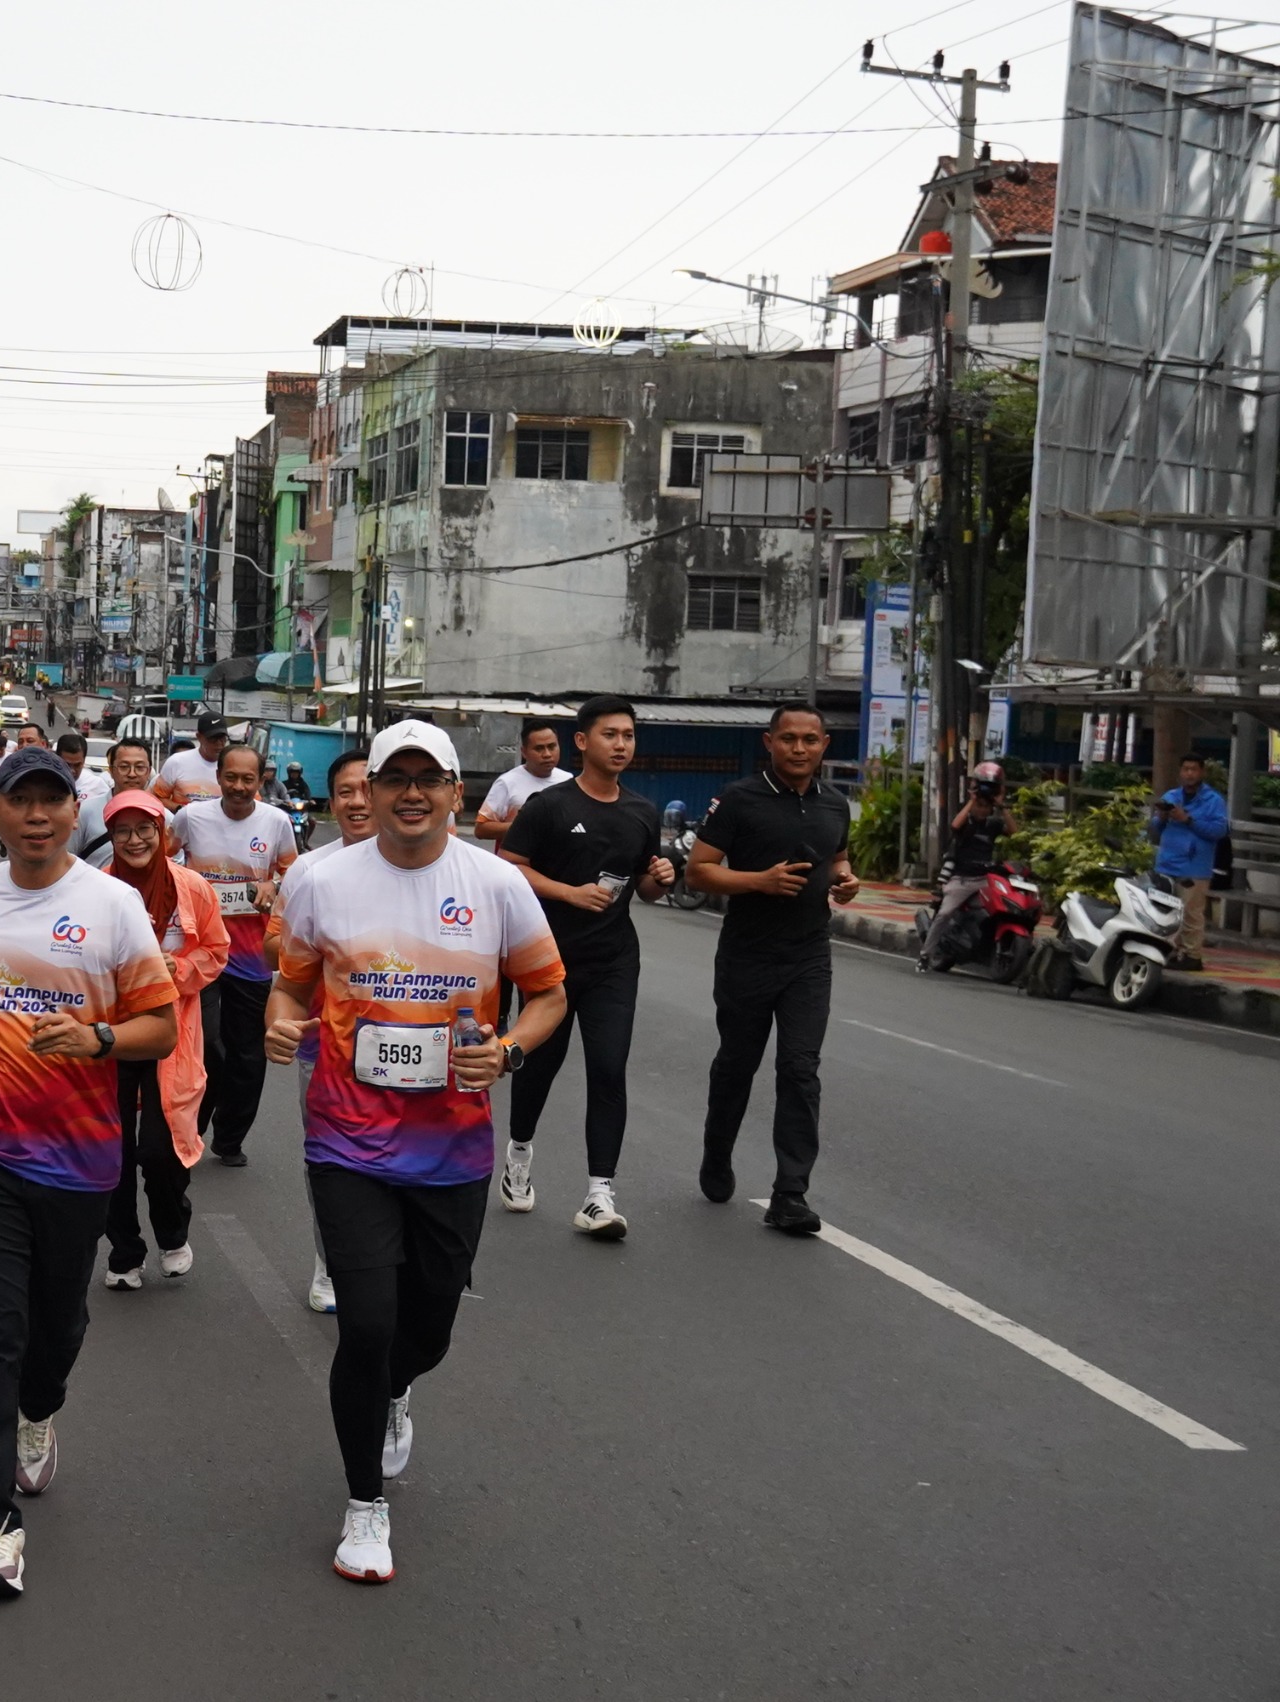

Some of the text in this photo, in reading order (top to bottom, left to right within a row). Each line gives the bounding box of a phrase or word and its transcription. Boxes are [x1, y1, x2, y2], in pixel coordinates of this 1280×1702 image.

[221, 891, 244, 903] 3574
[349, 972, 477, 989] BANK LAMPUNG
[4, 986, 85, 1006] LAMPUNG
[372, 985, 449, 1001] RUN 2026
[21, 1000, 57, 1014] 2026
[378, 1043, 422, 1065] 5593
[372, 1067, 389, 1077] 5K
